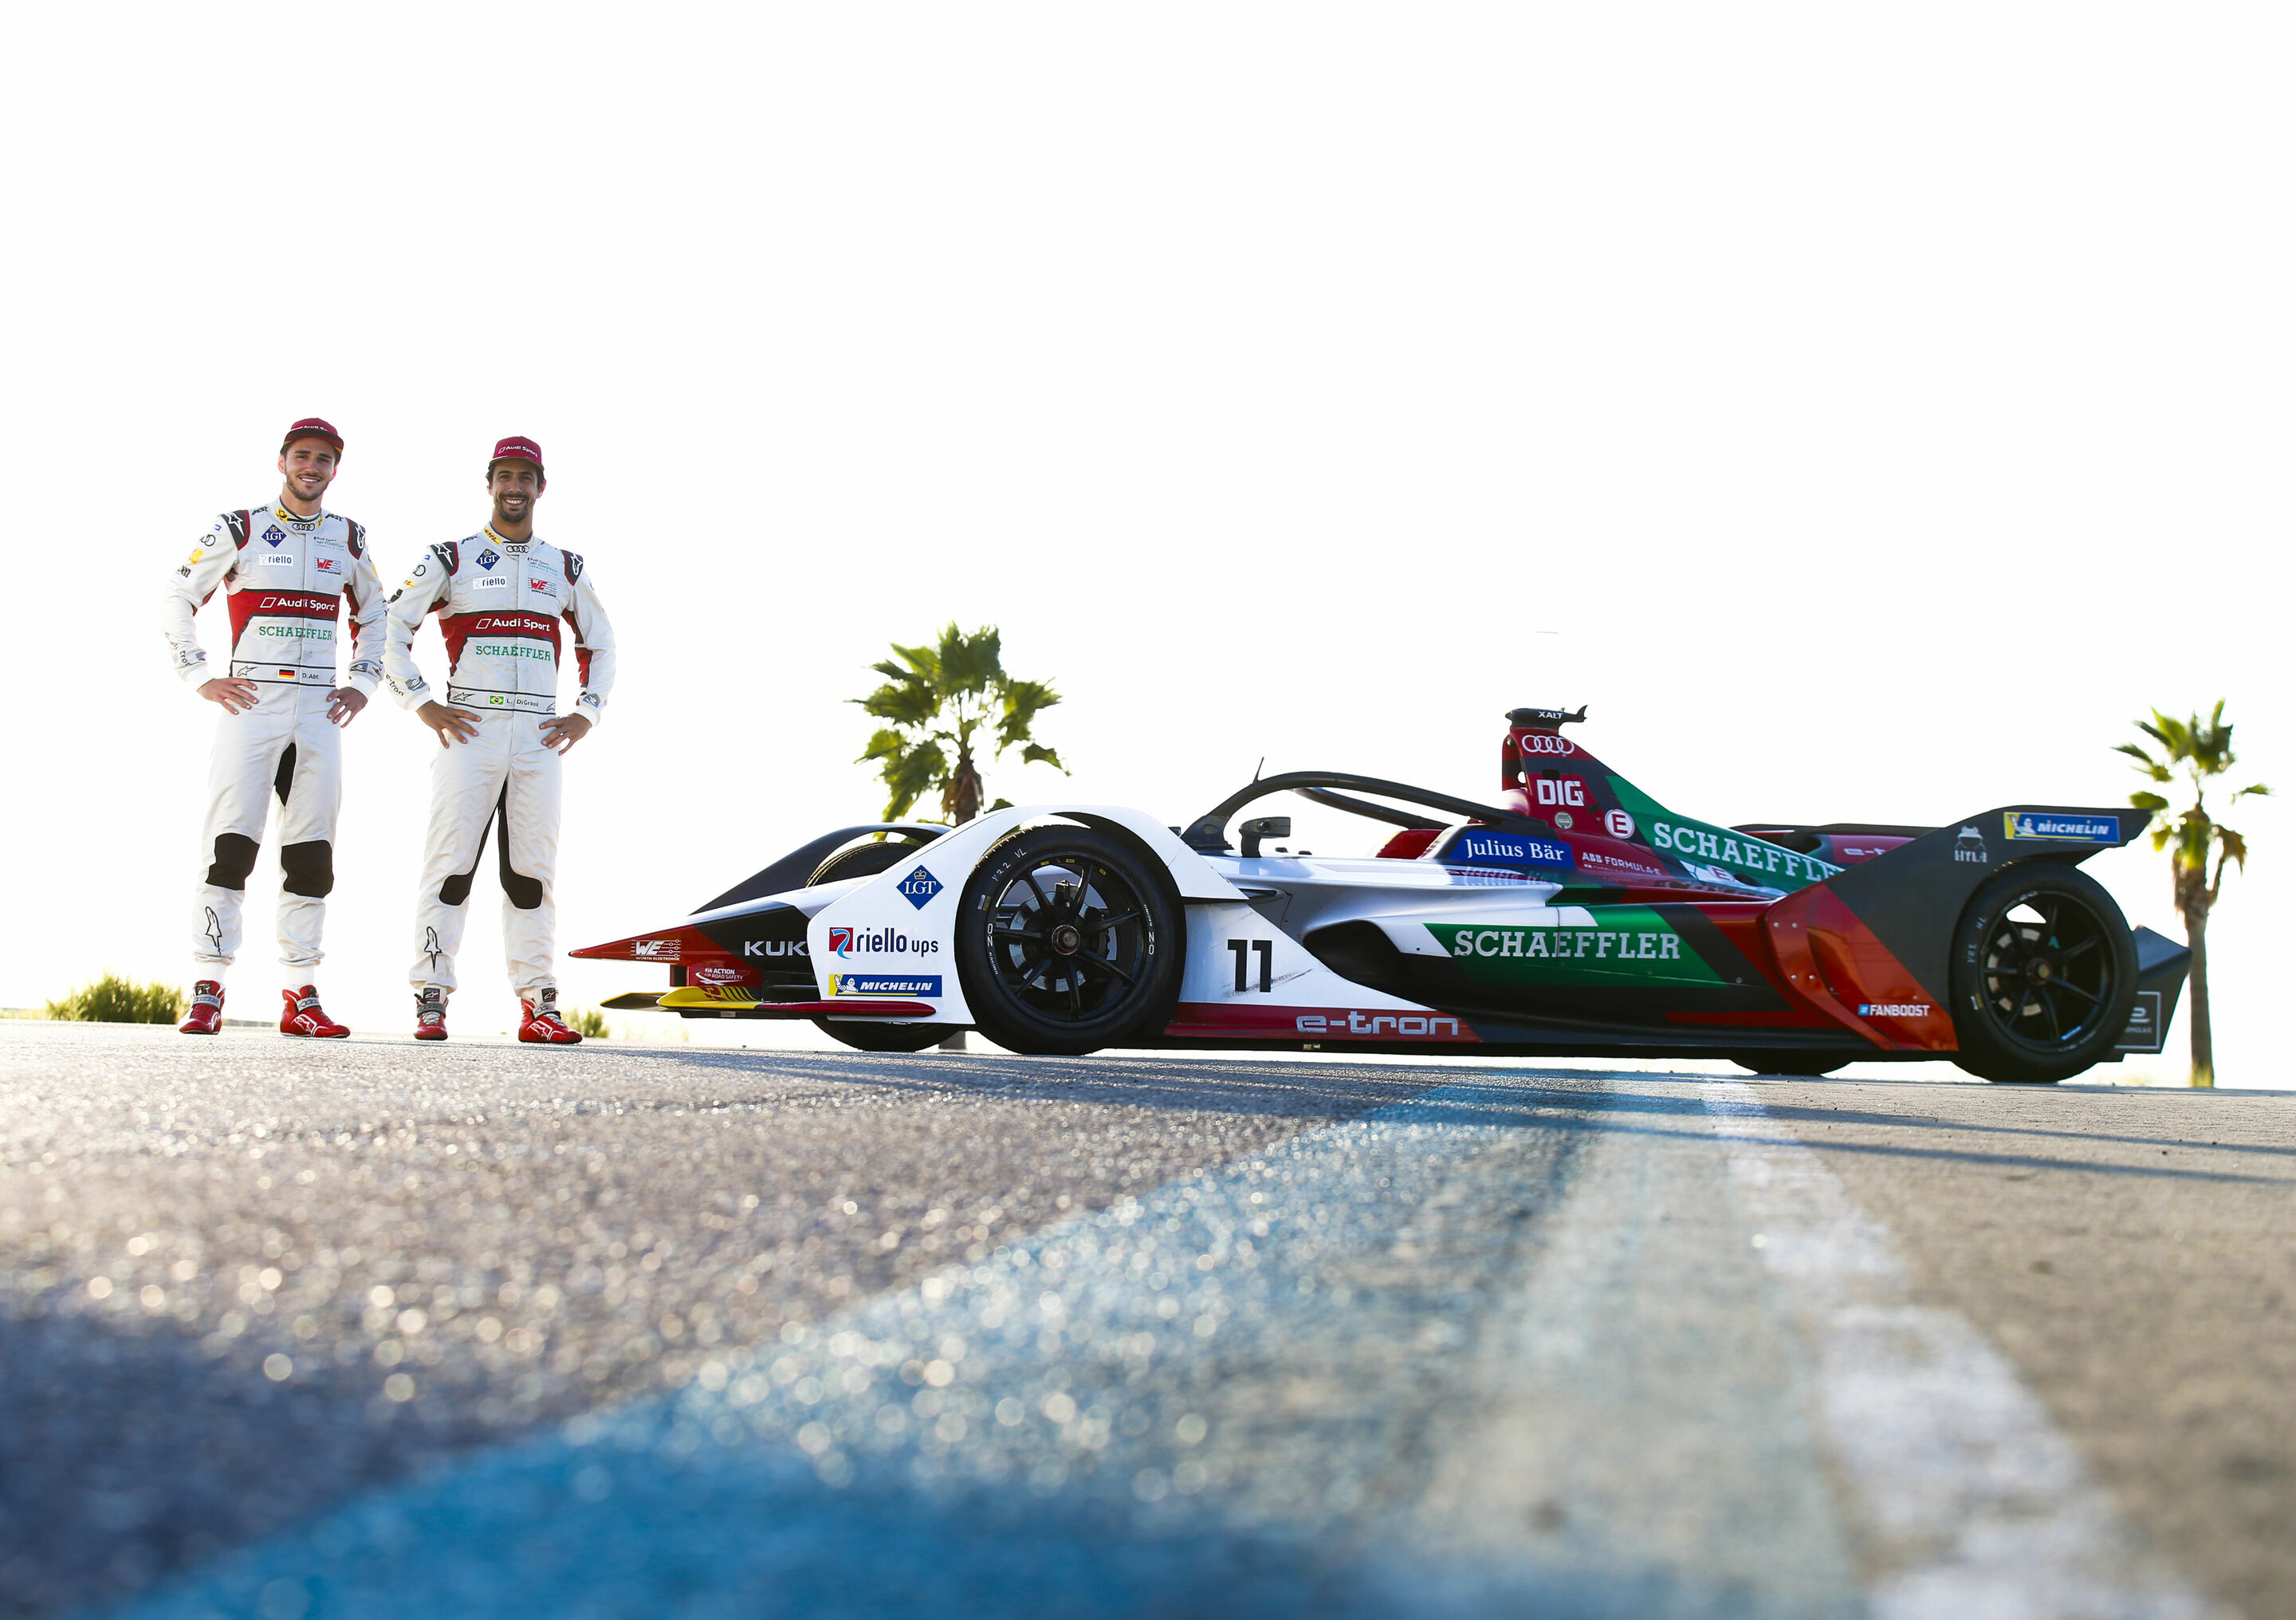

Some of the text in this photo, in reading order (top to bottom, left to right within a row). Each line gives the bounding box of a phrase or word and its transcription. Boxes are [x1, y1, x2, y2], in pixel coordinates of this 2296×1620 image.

[522, 446, 538, 458] Sport
[265, 532, 284, 541] LGT
[479, 554, 497, 564] LGT
[482, 577, 505, 587] riello
[277, 597, 335, 611] Audi Sport
[492, 618, 551, 631] Audi Sport
[259, 626, 332, 640] SCHAEFFLER
[476, 645, 551, 661] SCHAEFFLER
[1536, 779, 1585, 807] DIG
[2037, 820, 2109, 835] MICHELIN
[1465, 839, 1564, 861] Julius Bär
[1582, 851, 1602, 863] ABB
[904, 880, 937, 895] LGT
[745, 941, 810, 956] KUK
[856, 927, 939, 957] riello ups
[1454, 930, 1681, 959] SCHAEFFLER
[1228, 939, 1273, 993] 11
[860, 981, 932, 991] MICHELIN
[1296, 1010, 1458, 1036] e-tron
